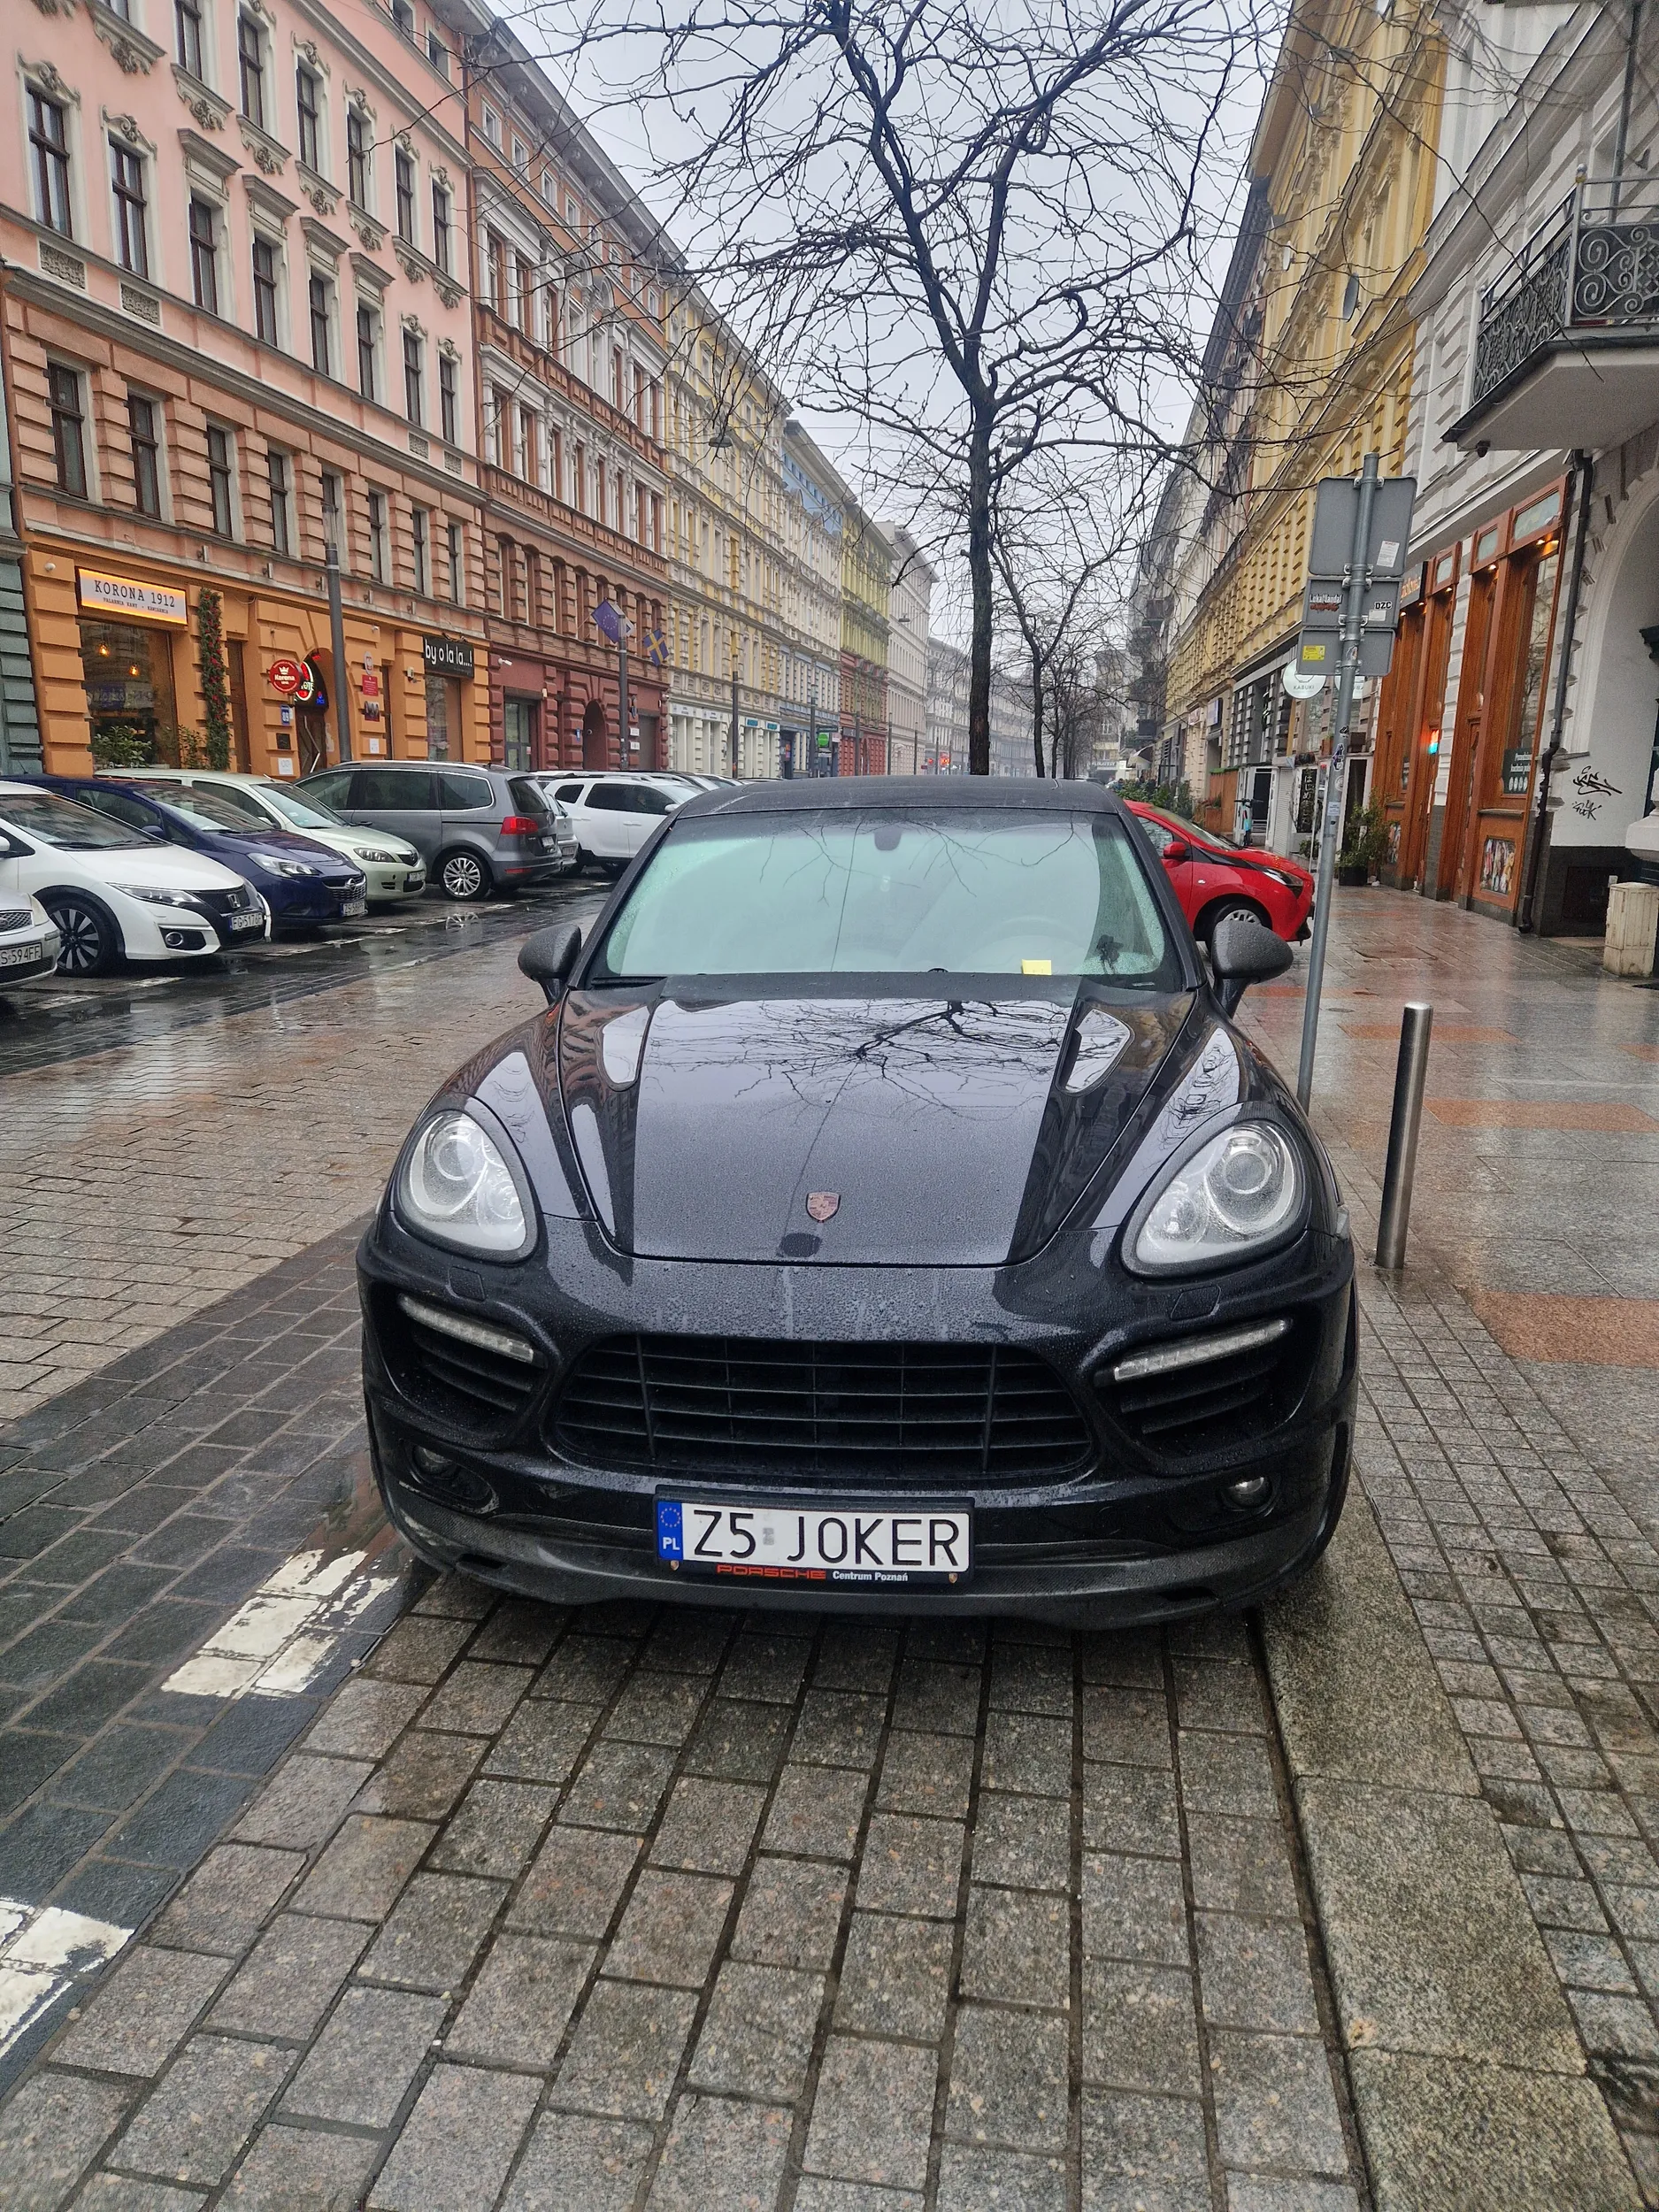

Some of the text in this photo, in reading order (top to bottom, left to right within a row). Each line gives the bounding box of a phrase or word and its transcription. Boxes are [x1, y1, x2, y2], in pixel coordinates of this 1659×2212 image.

[94, 580, 175, 608] KORONA 1912
[425, 638, 437, 665] by
[438, 647, 445, 662] o
[446, 643, 454, 664] la
[663, 1537, 680, 1550] PL
[694, 1509, 960, 1566] Z5 JOKER
[716, 1564, 909, 1582] PORSCHE Centrum Poznań
